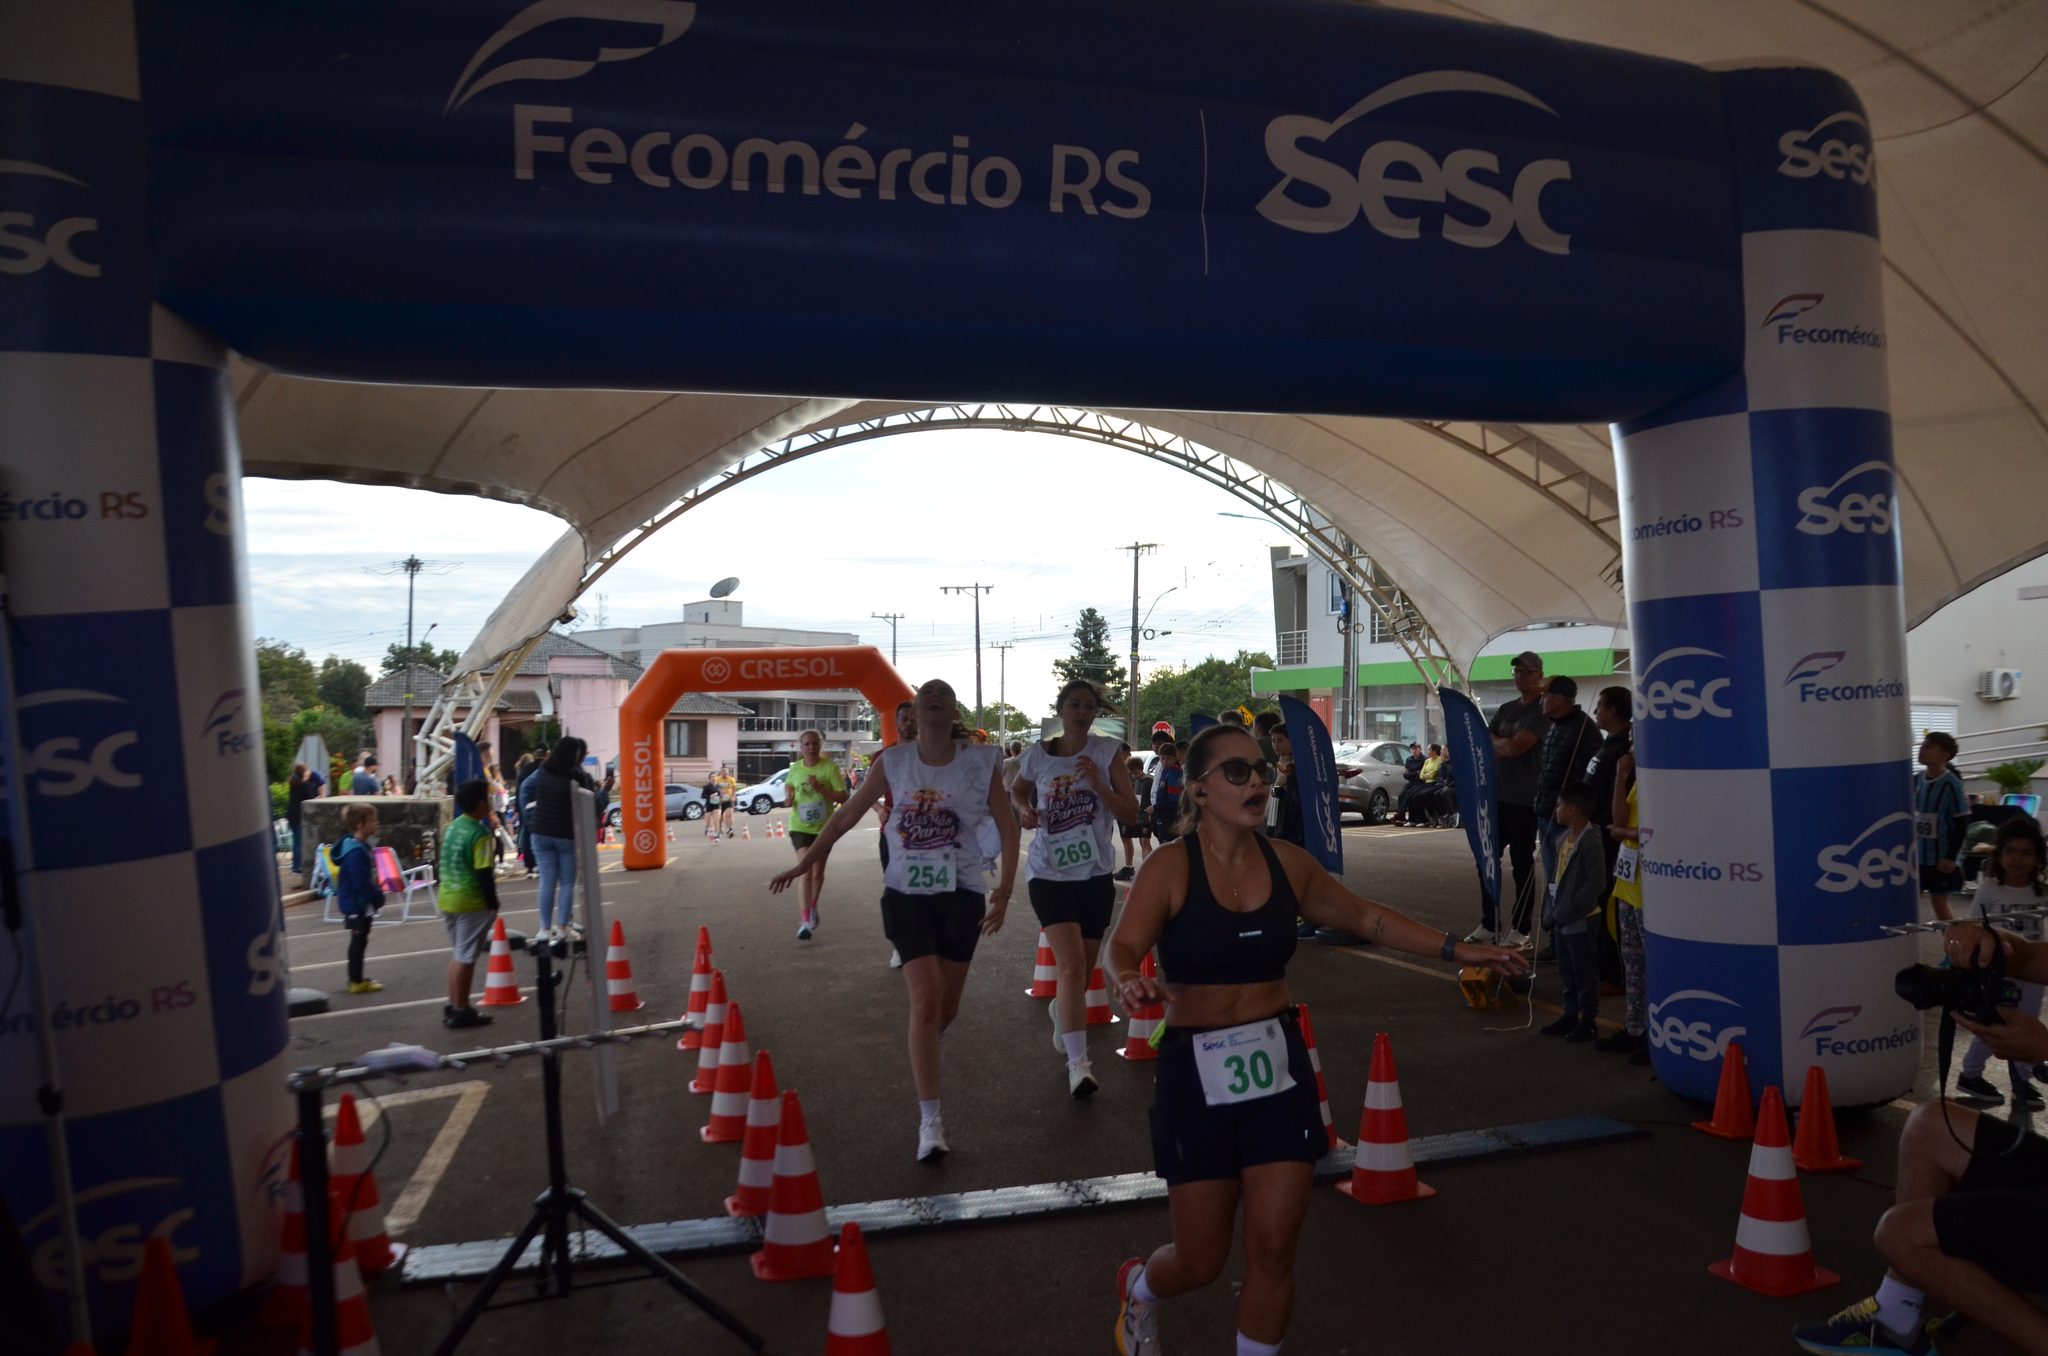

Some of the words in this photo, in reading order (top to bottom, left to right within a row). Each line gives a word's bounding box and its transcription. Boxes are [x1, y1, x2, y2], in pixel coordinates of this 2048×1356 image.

[514, 103, 1022, 210] Fecomércio
[1049, 143, 1152, 219] RS
[1255, 113, 1572, 255] Sesc
[0, 211, 102, 278] sc
[100, 491, 148, 520] RS
[1709, 507, 1744, 532] RS
[1795, 486, 1896, 536] Ses
[739, 656, 844, 680] CRESOL
[633, 734, 654, 824] CRESOL
[806, 808, 820, 821] 56
[1054, 840, 1092, 868] 269
[908, 864, 950, 888] 254
[1730, 862, 1763, 883] RS
[151, 980, 197, 1014] RS
[1815, 1024, 1919, 1057] Fecomércio
[1223, 1049, 1274, 1095] 30
